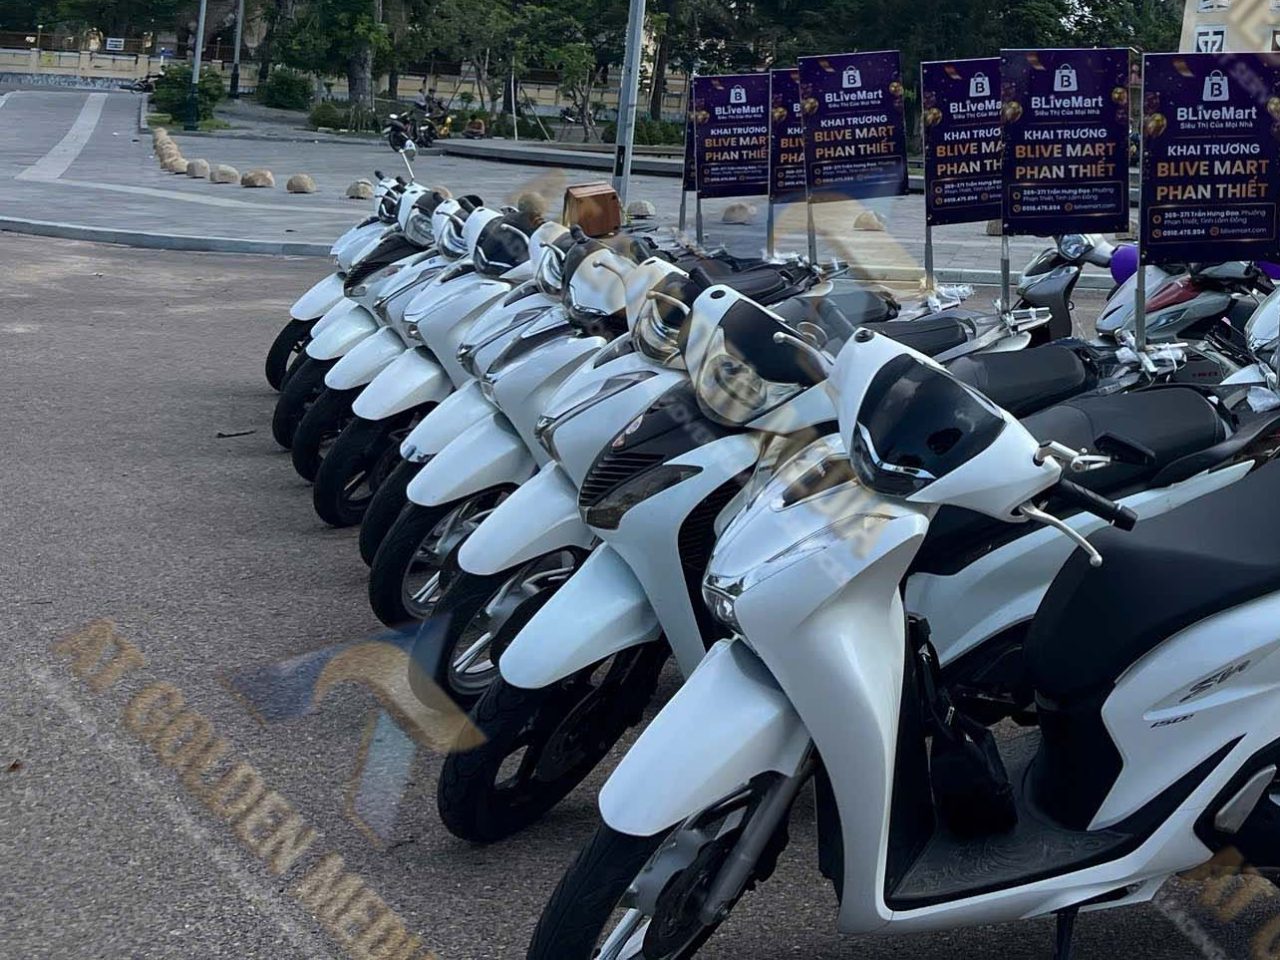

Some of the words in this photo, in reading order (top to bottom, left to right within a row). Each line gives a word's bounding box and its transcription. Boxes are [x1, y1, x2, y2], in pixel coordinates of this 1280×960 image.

[825, 89, 882, 102] BLiveMart
[1031, 94, 1103, 109] BLiveMart
[715, 105, 764, 115] BLiveMart
[950, 100, 1002, 113] BLiveMa
[1177, 104, 1257, 120] BLiveMart
[821, 119, 844, 128] KHAI
[847, 115, 887, 125] TRƯƠNG
[733, 126, 767, 134] TRƯƠNG
[815, 129, 852, 142] BLIVE
[856, 126, 895, 139] MART
[944, 131, 970, 141] KHAI
[1024, 130, 1053, 140] KHAI
[1056, 128, 1107, 139] TRƯƠNG
[705, 137, 736, 147] BLIVE
[740, 136, 769, 146] MAR
[816, 145, 855, 158] PHAN
[858, 138, 895, 155] THIẾT
[705, 151, 739, 161] PHAN
[741, 146, 768, 159] THIẾ
[936, 143, 978, 157] BLIVE
[1016, 145, 1062, 158] BLIVE
[1066, 143, 1116, 157] MART
[1168, 145, 1200, 156] KHAI
[1204, 142, 1260, 155] TRƯƠNG
[781, 153, 805, 163] PHA
[937, 161, 980, 176] PHAN
[1016, 165, 1064, 179] PHAN
[1068, 157, 1115, 178] THIẾT
[1157, 161, 1208, 177] BLIVE
[1214, 160, 1269, 175] MART
[1157, 184, 1211, 200] PHAN
[1216, 176, 1268, 198] THIẾT
